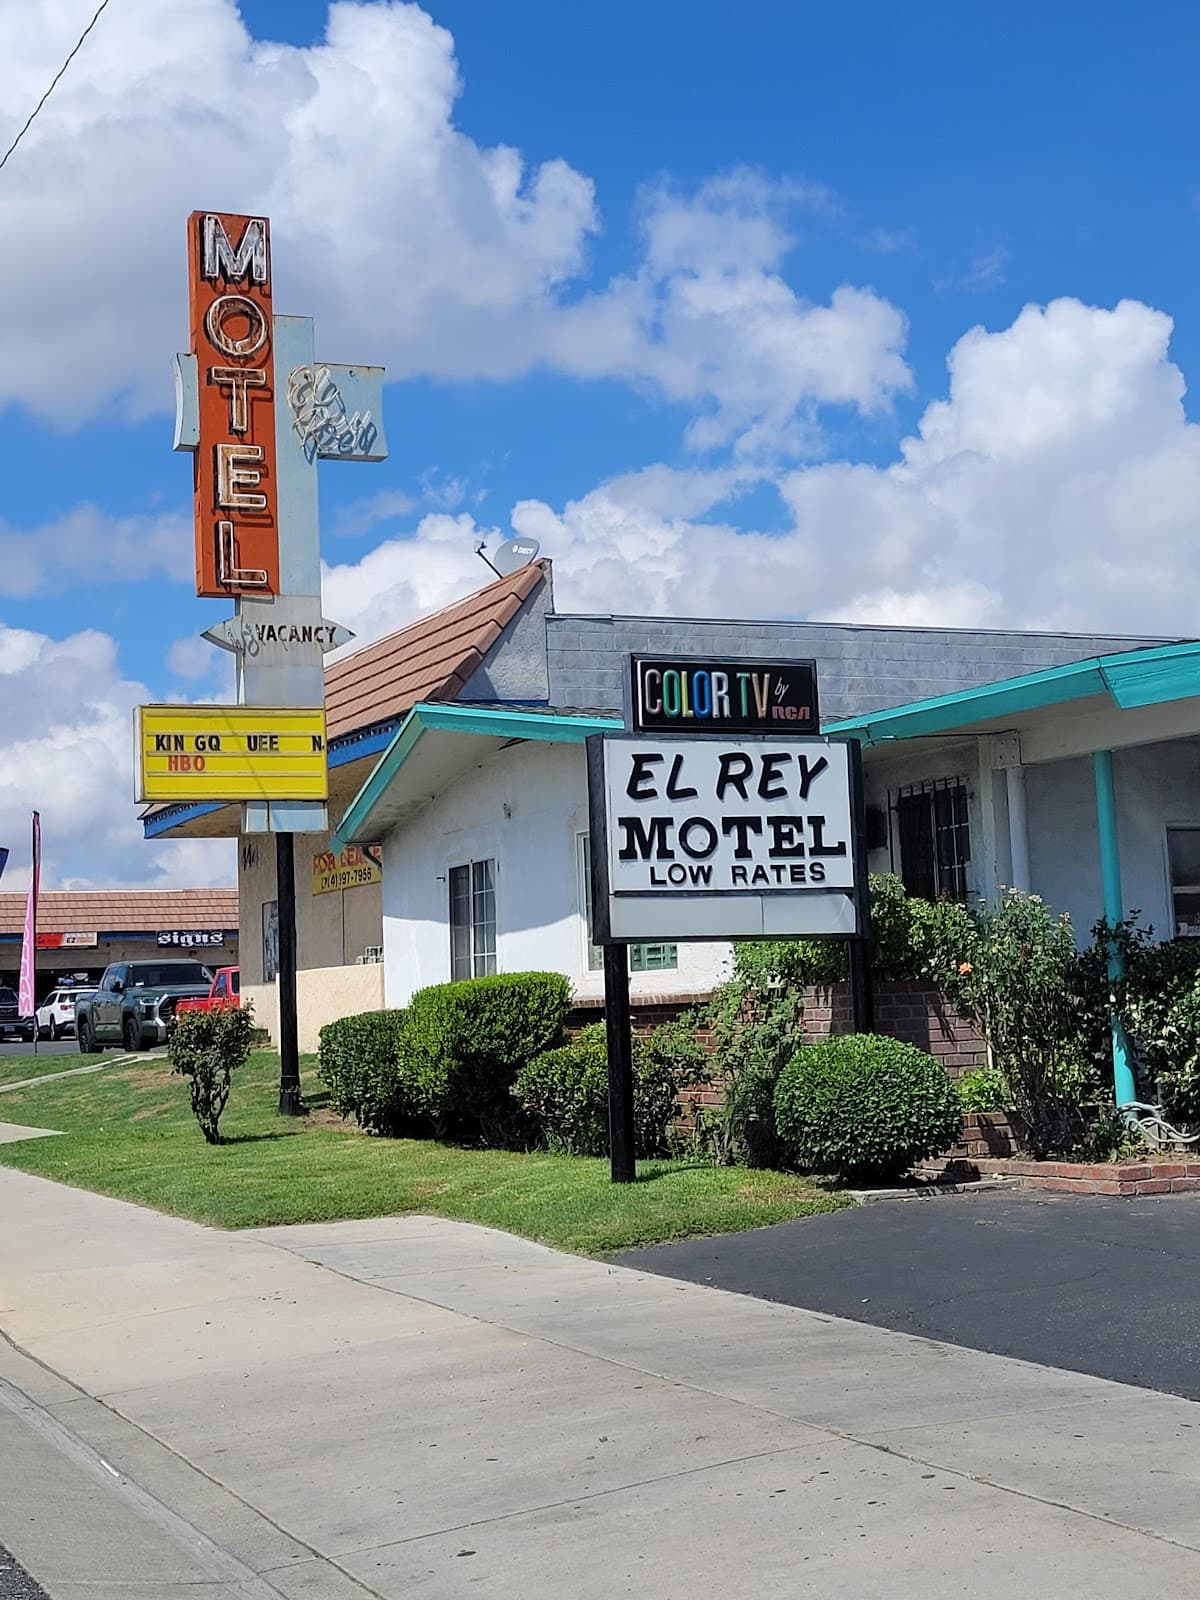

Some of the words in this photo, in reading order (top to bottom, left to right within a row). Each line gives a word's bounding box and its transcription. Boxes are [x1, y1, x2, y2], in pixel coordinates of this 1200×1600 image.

[202, 214, 270, 587] MOTEL
[256, 624, 336, 643] VACANCY
[645, 669, 731, 718] COLOR
[737, 673, 770, 718] TV
[774, 676, 789, 703] by
[771, 706, 810, 720] RCA
[168, 755, 205, 771] HBO
[626, 753, 698, 799] EL
[716, 752, 828, 800] REY
[618, 815, 847, 860] MOTEL
[650, 863, 712, 885] LOW
[731, 862, 825, 884] RATES
